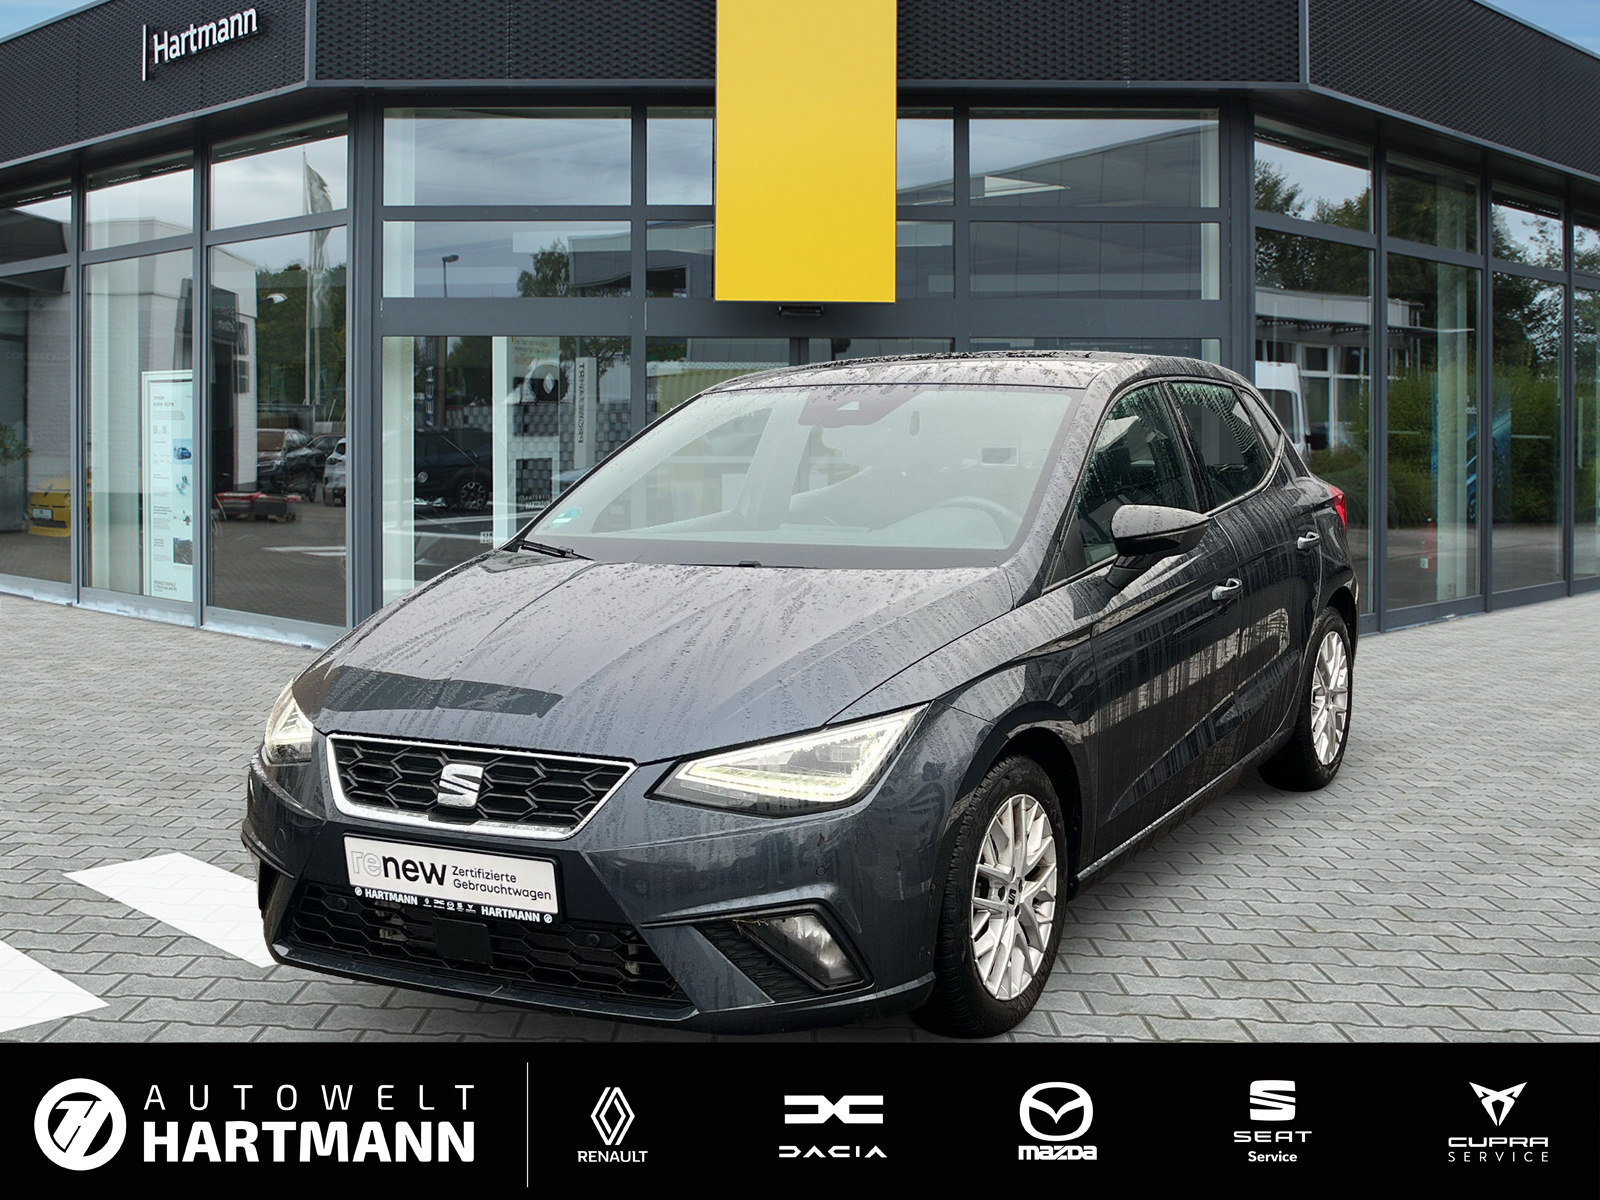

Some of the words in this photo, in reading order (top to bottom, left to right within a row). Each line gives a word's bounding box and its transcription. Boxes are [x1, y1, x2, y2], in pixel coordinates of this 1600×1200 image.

[153, 8, 258, 64] Hartmann
[351, 851, 447, 886] renew
[452, 866, 517, 883] Zertifizierte
[364, 888, 418, 906] HARTMANN
[453, 879, 552, 901] Gebrauchtwagen
[481, 905, 541, 923] HARTMANN
